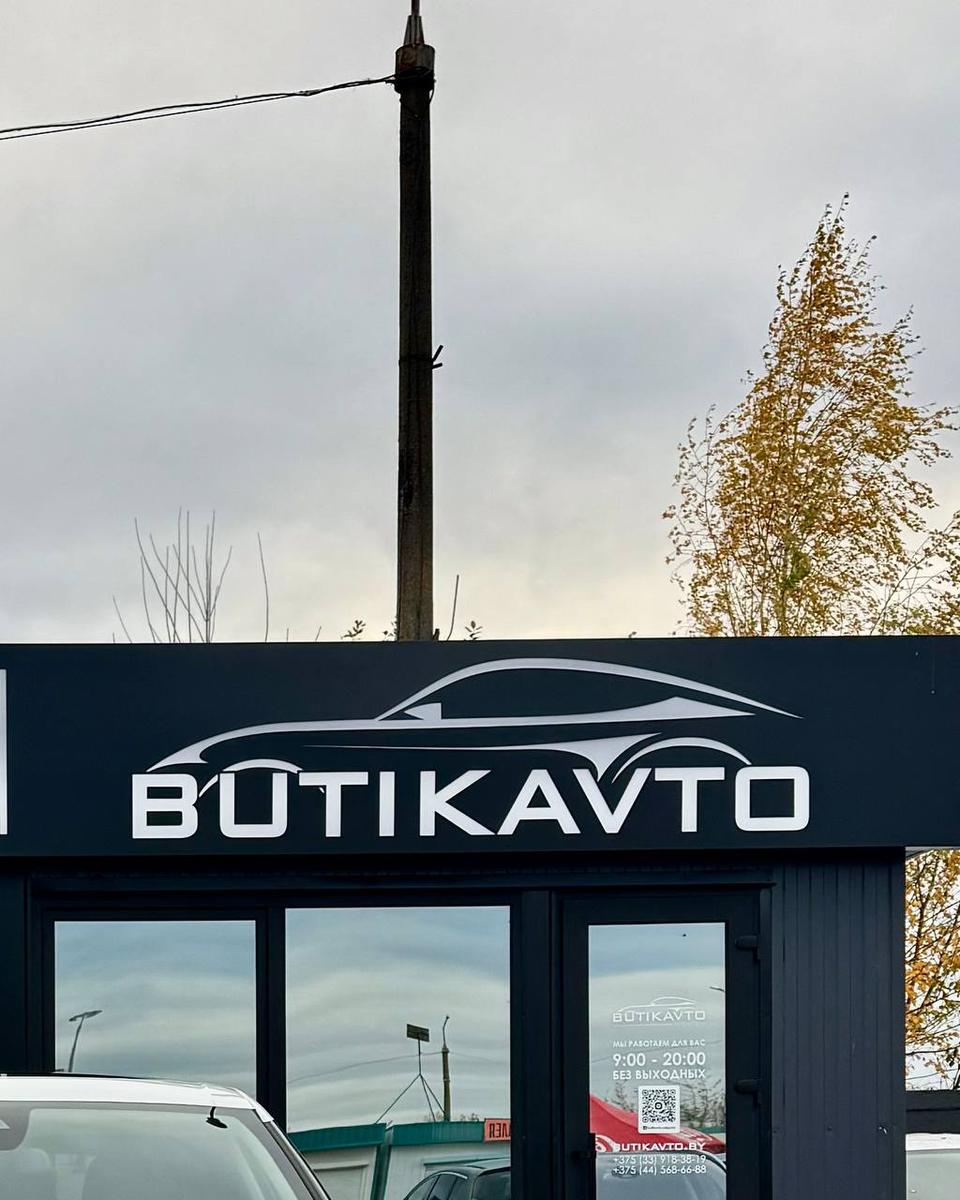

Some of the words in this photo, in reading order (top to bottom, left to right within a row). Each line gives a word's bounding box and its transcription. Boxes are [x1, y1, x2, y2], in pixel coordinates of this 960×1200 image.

[131, 765, 811, 840] BUTIKAVTO
[612, 1010, 706, 1022] BUTIKAVTO
[612, 1052, 646, 1067] 9:00
[662, 1051, 707, 1066] 20:00
[612, 1070, 632, 1080] БЕЗ
[635, 1069, 706, 1081] ВЫХОДНЫХ
[613, 1142, 706, 1152] BUTIKAVTO.BY
